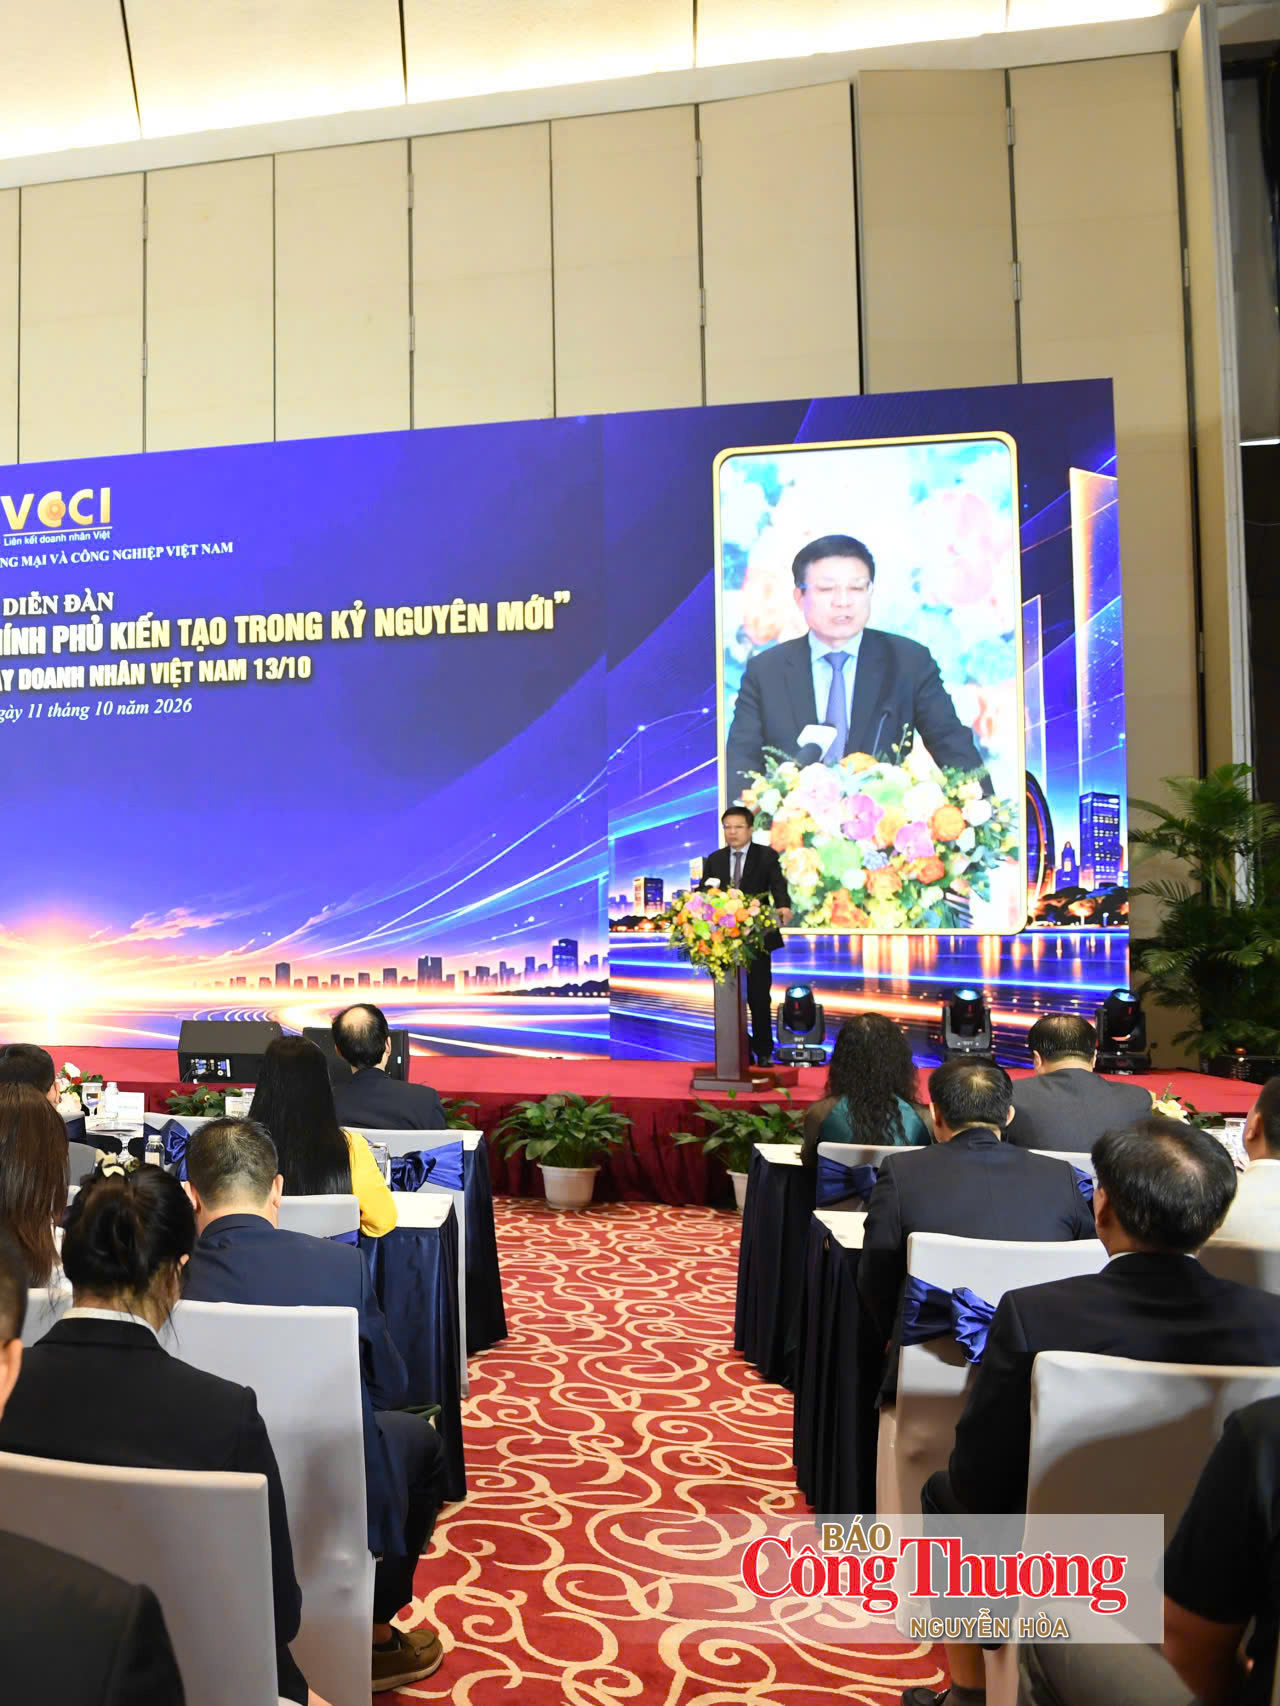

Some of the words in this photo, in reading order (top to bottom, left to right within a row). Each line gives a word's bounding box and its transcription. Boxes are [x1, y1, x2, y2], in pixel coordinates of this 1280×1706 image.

[0, 487, 111, 530] VCCI
[4, 537, 22, 546] Liên
[24, 534, 38, 545] kết
[39, 533, 66, 544] doanh
[69, 532, 90, 542] nhân
[93, 530, 110, 541] Việt
[21, 554, 47, 568] MẠI
[49, 551, 68, 565] VÀ
[70, 549, 110, 563] CÔNG
[112, 546, 164, 561] NGHIỆP
[166, 544, 199, 559] VIỆT
[201, 542, 233, 555] NAM
[2, 591, 59, 616] DIỄN
[63, 587, 114, 613] ĐÀN
[52, 614, 103, 654] PHỦ
[110, 611, 170, 650] KIẾN
[177, 616, 227, 652] TẠO
[234, 611, 323, 645] TRONG
[330, 599, 367, 639] KỶ
[374, 598, 489, 637] NGUYÊN
[496, 590, 571, 632] MỚI”
[18, 665, 85, 691] DOANH
[89, 659, 145, 688] NHÂN
[150, 657, 194, 689] VIỆT
[198, 658, 247, 683] NAM
[253, 655, 312, 681] 13/10
[28, 703, 43, 719] 11
[47, 703, 90, 721] tháng
[95, 701, 114, 717] 10
[116, 702, 150, 716] năm
[154, 698, 193, 715] 2026
